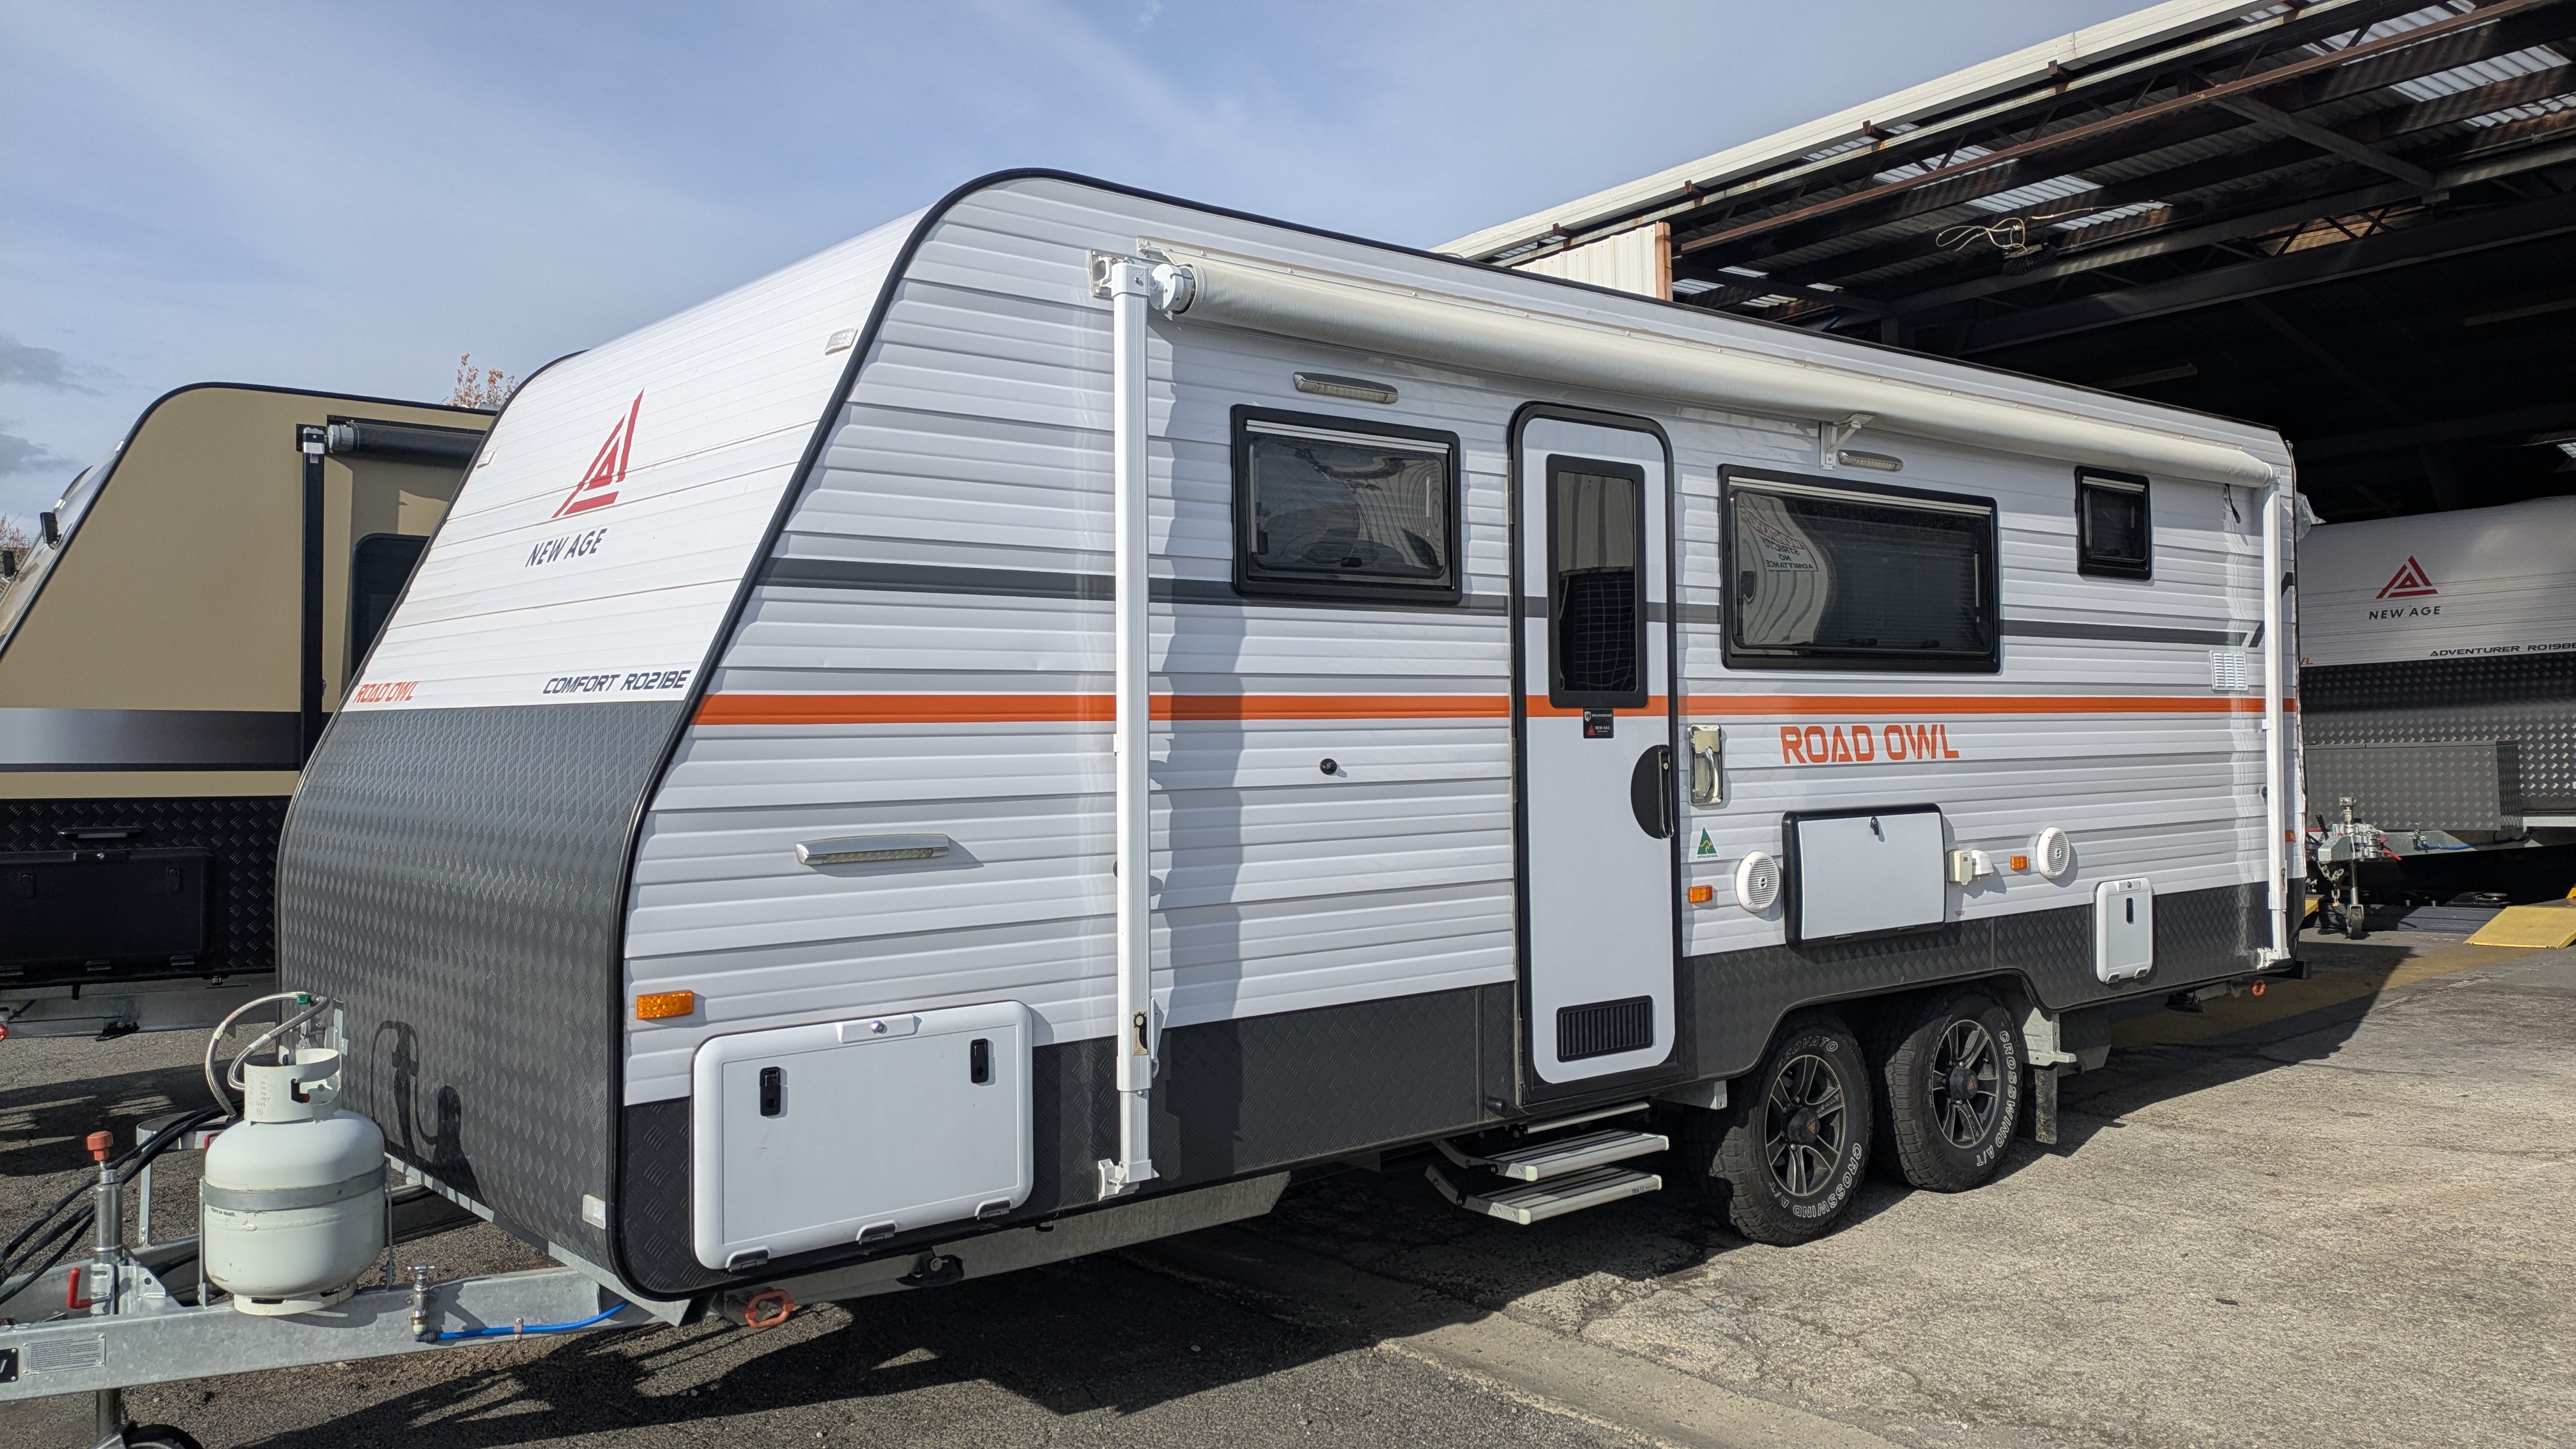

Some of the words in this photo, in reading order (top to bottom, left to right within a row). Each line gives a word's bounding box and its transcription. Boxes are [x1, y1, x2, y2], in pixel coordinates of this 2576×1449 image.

[525, 536, 570, 567] NEW
[563, 528, 608, 560] AGE
[2369, 609, 2404, 620] NEW
[2409, 606, 2441, 617] AGE
[2430, 645, 2520, 656] ADVENTURER
[352, 684, 392, 703] ROAD
[385, 680, 419, 702] OWL
[543, 674, 621, 694] COMFORT
[1780, 725, 1874, 764] ROAD
[1883, 724, 1959, 761] OWL
[1995, 1031, 2018, 1147] CROSSWIND
[1976, 1145, 1995, 1167] A/T
[1793, 1143, 1862, 1218] CROSSWIND
[1769, 1182, 1790, 1208] A/T
